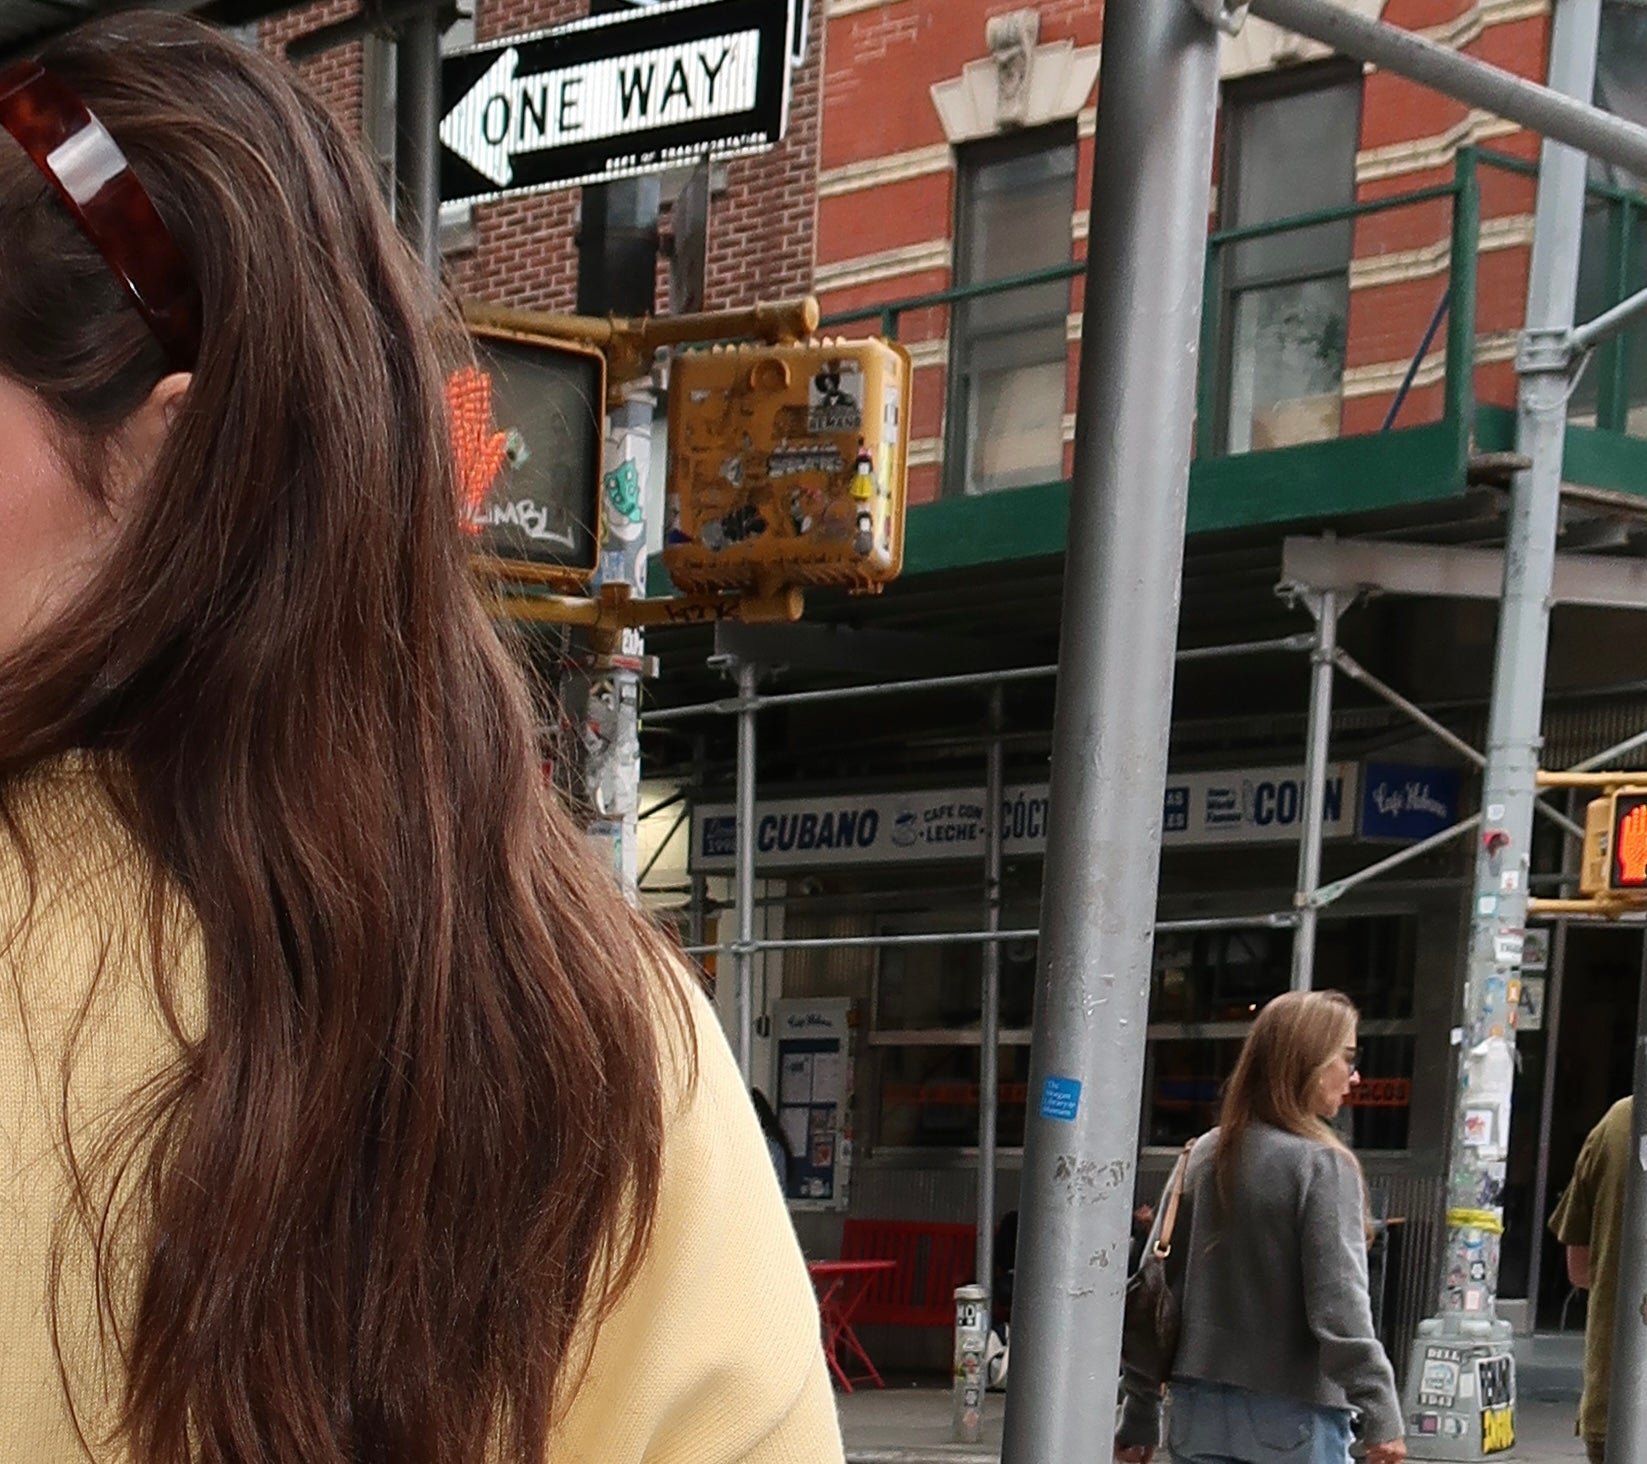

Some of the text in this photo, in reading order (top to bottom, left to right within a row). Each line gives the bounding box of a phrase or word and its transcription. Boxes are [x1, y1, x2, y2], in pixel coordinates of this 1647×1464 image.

[483, 47, 731, 146] ONE WAY
[923, 803, 984, 823] CAFE CON
[757, 808, 880, 851] CUBANO
[924, 823, 977, 844] LECHE
